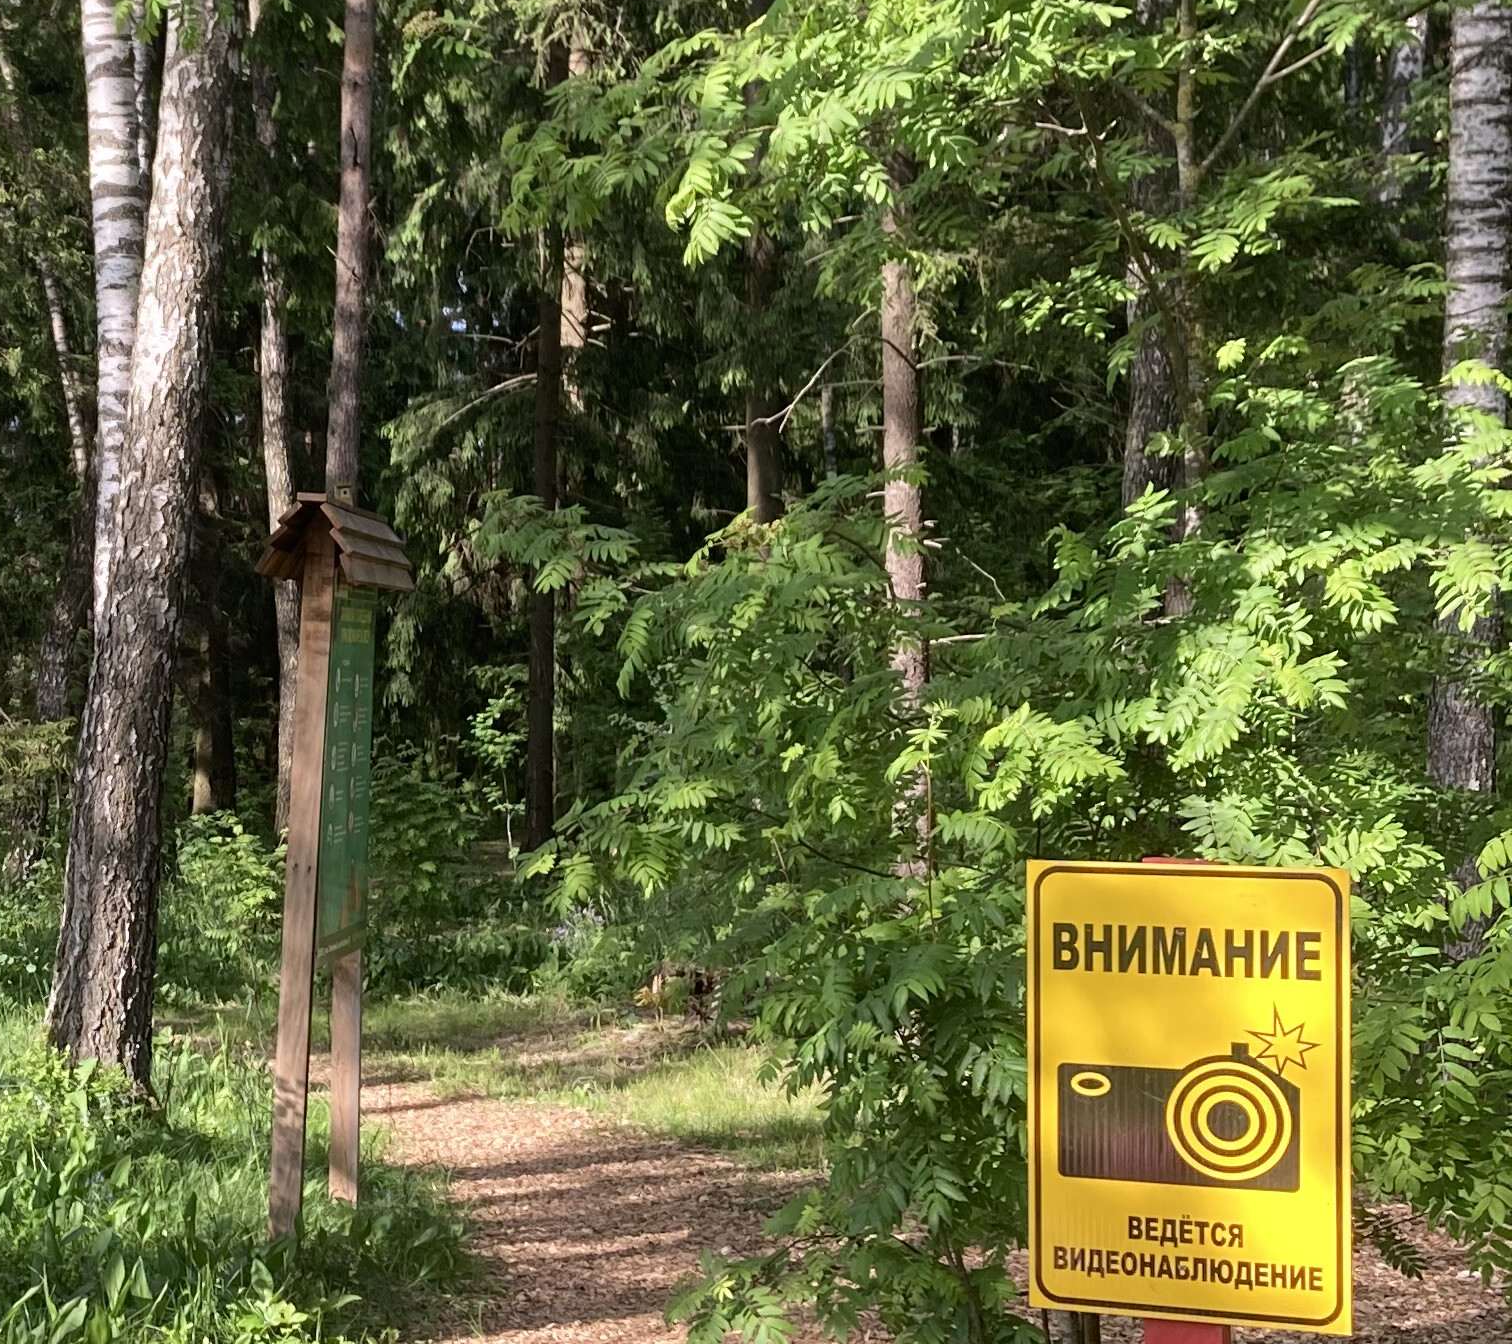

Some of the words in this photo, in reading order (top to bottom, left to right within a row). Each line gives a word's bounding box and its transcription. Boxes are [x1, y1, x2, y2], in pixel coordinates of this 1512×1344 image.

[1052, 922, 1322, 981] ВНИМАНИЕ
[1128, 1214, 1244, 1248] ВЕДЁТСЯ
[1053, 1246, 1324, 1292] ВИДЕОНАБЛЮДЕНИЕ
